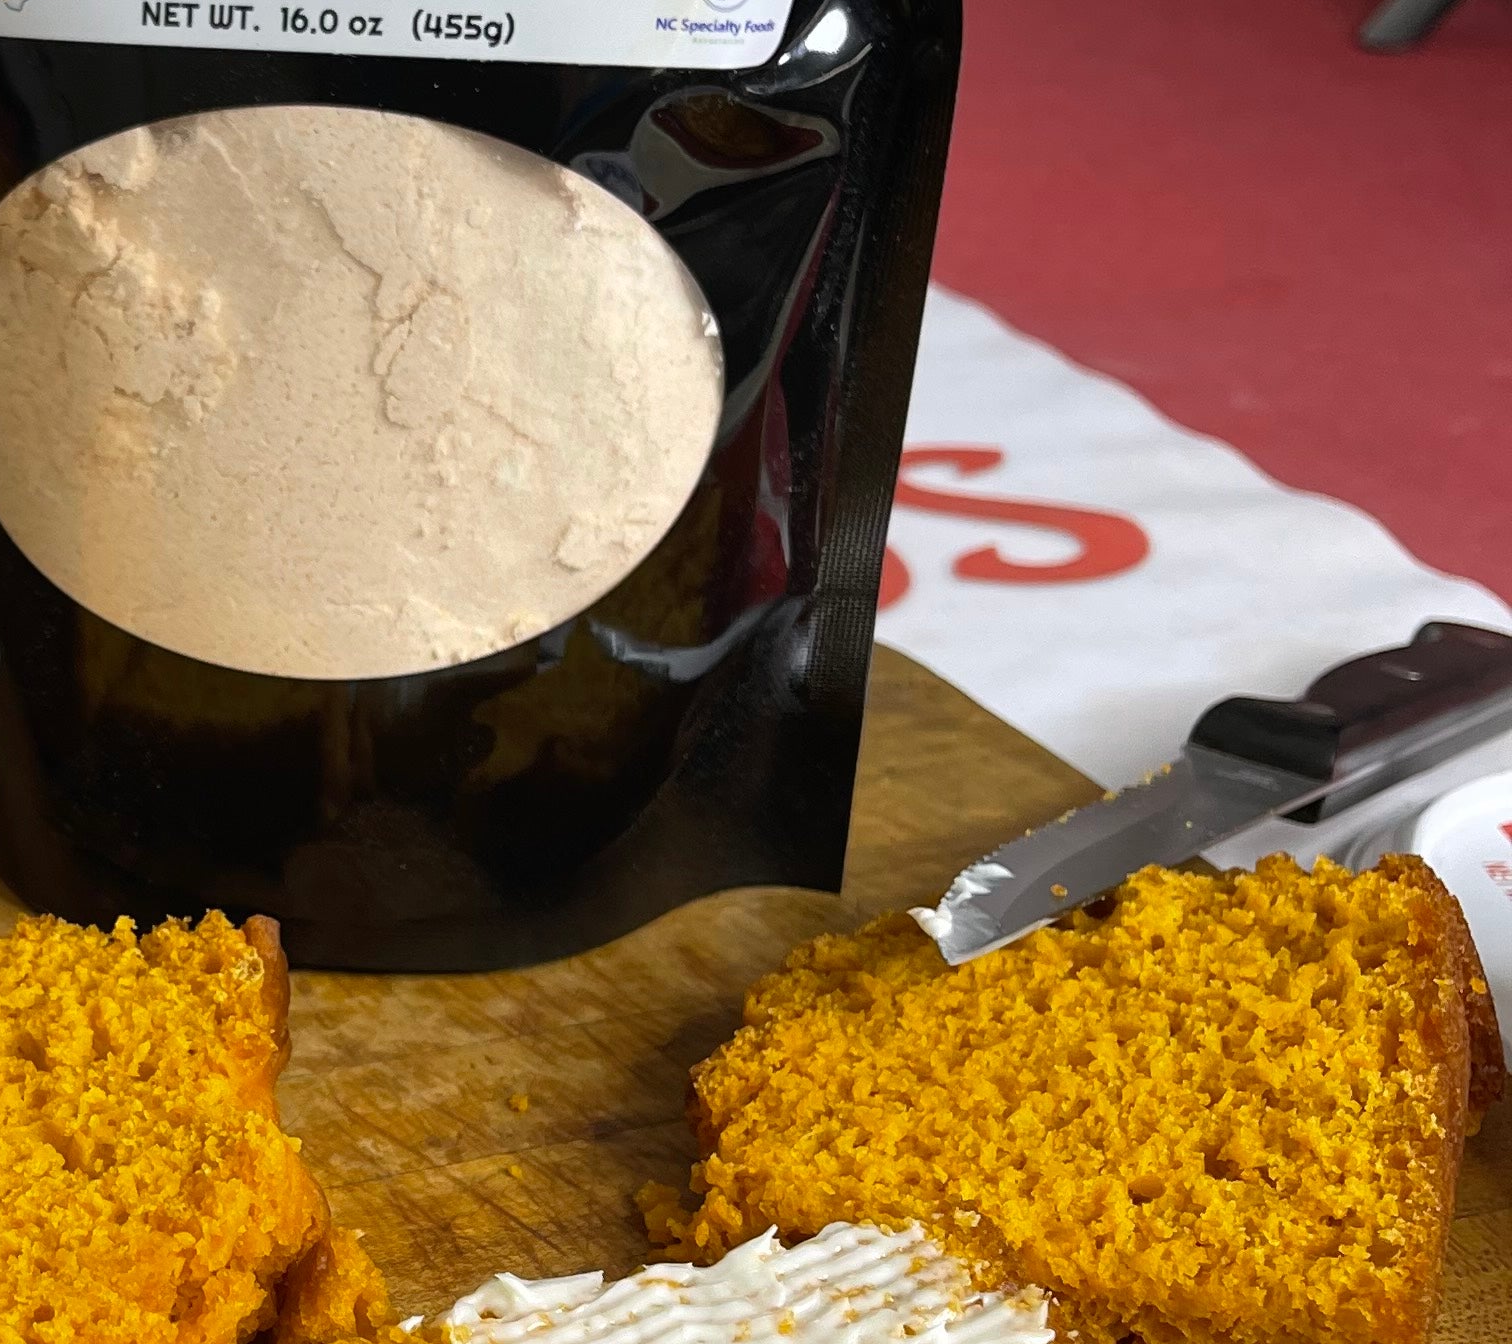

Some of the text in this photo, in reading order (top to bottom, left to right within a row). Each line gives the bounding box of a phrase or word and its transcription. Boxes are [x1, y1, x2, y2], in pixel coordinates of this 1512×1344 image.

[141, 0, 515, 45] NET WT. 16.0 oz (455g)
[656, 18, 678, 31] NC
[681, 19, 741, 36] Specialty
